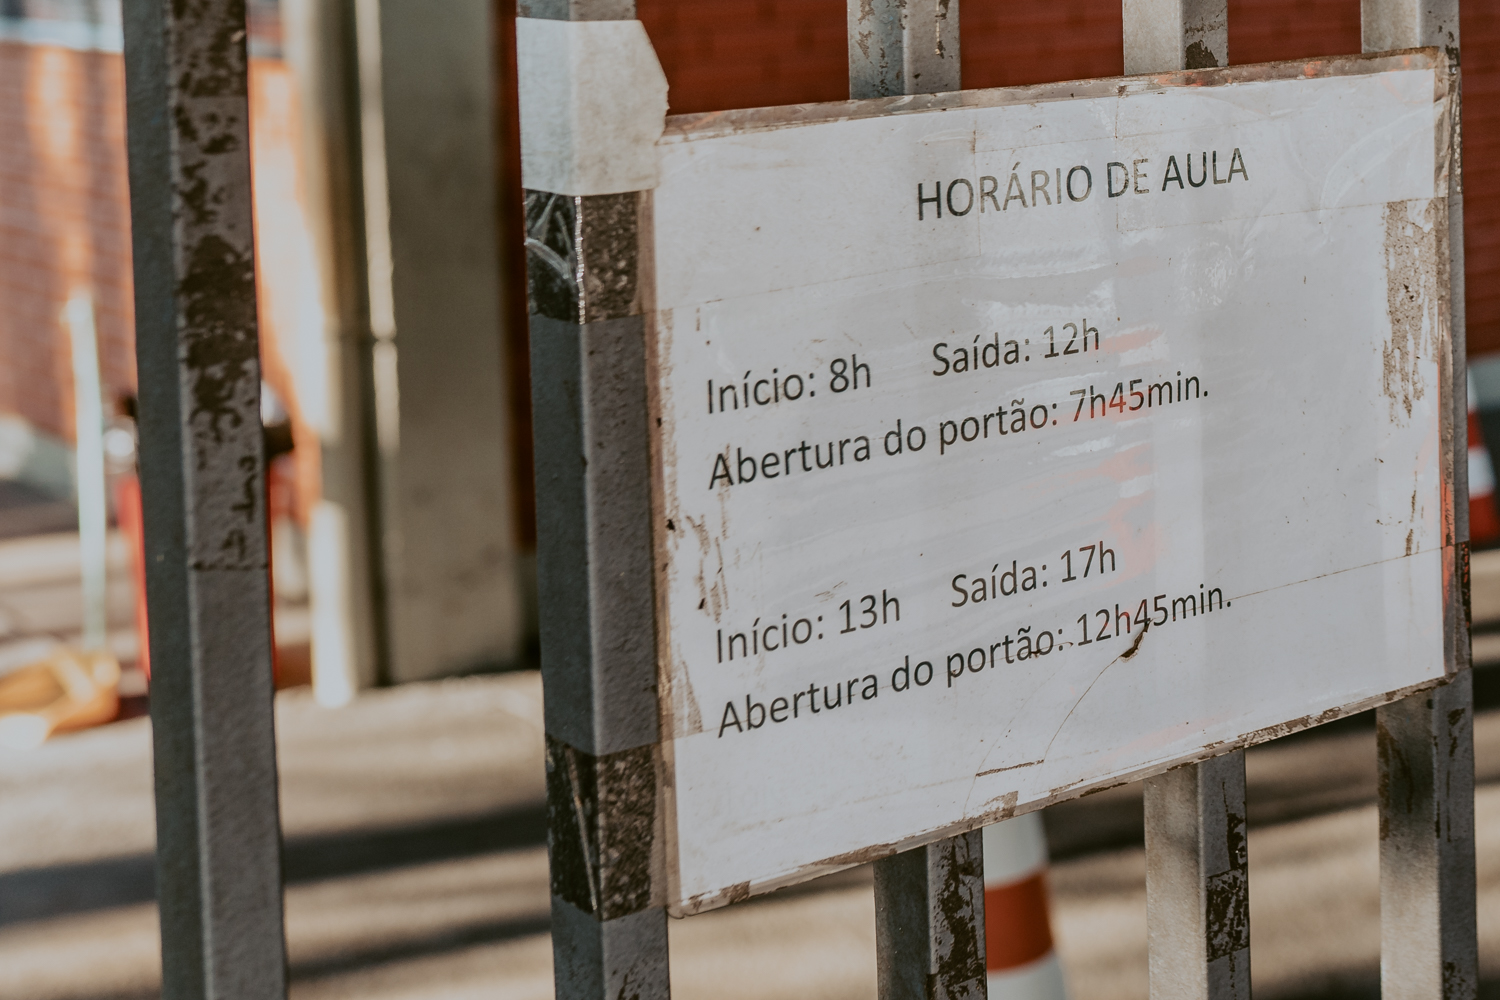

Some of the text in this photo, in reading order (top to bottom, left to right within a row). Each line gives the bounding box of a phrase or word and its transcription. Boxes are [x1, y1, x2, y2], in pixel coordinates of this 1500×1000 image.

[917, 147, 1250, 221] HORÁRIO DE AULA
[708, 318, 1100, 414] Início: 8h Saída: 12h
[709, 370, 1209, 490] Abertura do portão: 7h45min.
[717, 540, 1116, 664] Início: 13h Saída: 17h
[718, 583, 1232, 739] Abertura do portão: 12h45min.
